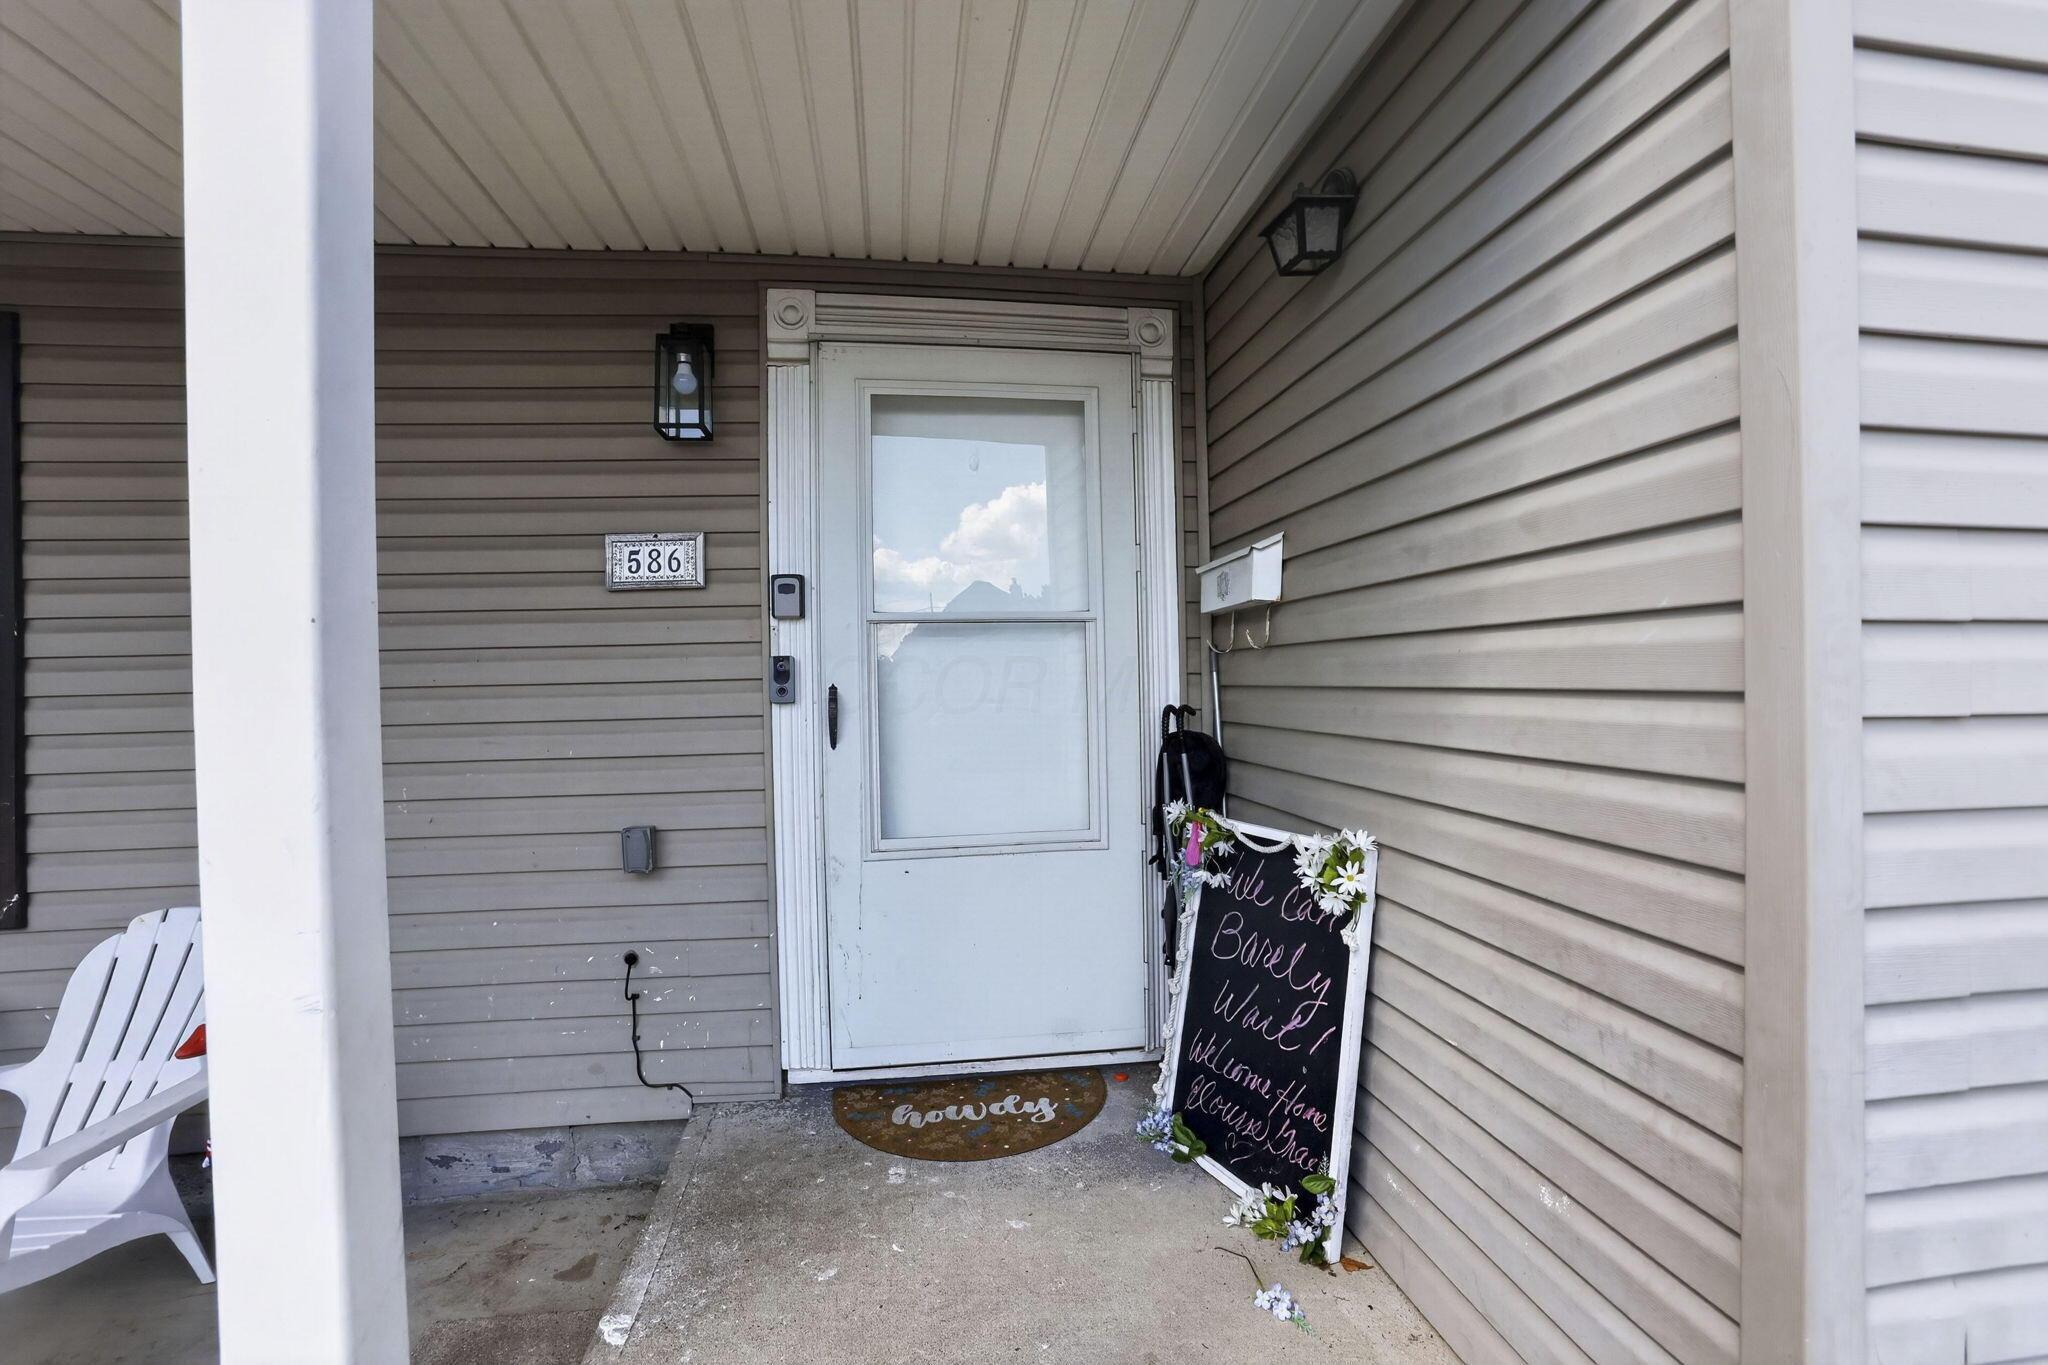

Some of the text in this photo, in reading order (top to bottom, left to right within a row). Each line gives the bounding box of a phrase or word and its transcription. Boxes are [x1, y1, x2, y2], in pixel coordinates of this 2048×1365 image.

[627, 548, 681, 574] 586
[1211, 911, 1333, 1028] Barely
[891, 1094, 1059, 1129] howdy
[1189, 1028, 1327, 1132] Welcome Home
